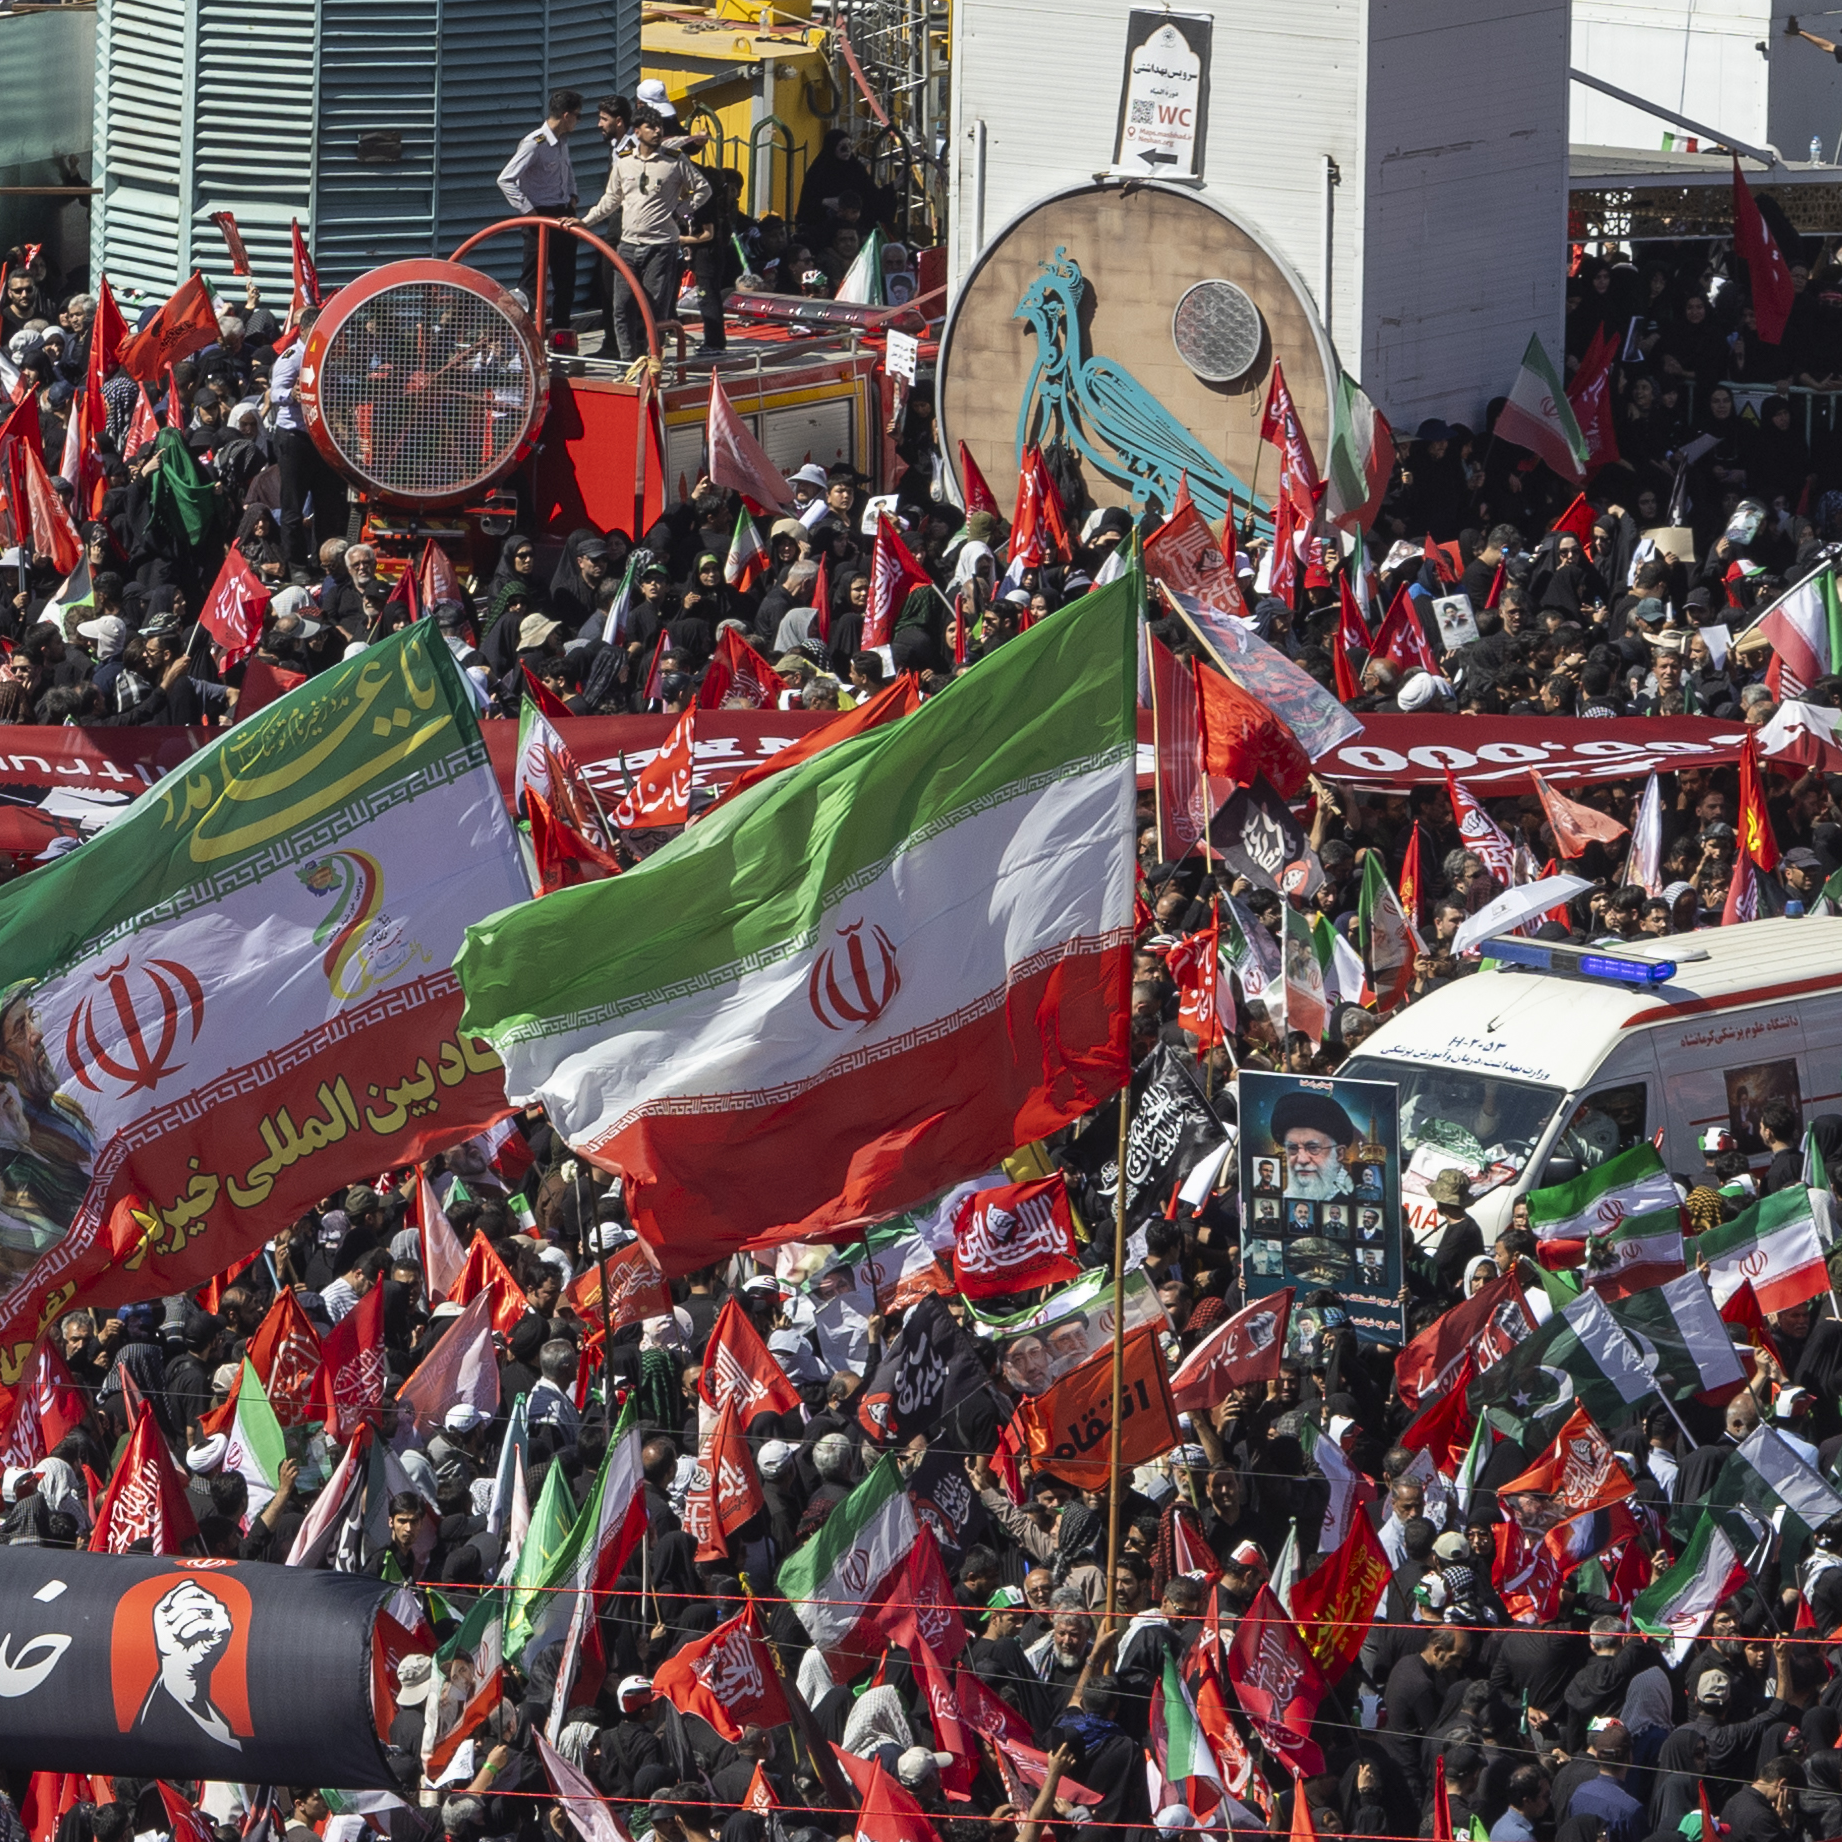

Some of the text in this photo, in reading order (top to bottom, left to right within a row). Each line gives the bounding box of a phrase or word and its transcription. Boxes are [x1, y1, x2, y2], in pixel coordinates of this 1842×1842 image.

[1158, 105, 1192, 127] WC
[1745, 1019, 1765, 1039] علوم
[1767, 1014, 1799, 1032] دانشگاه
[1380, 1044, 1413, 1057] پزشکی
[1522, 1066, 1552, 1081] وزارت
[1043, 1378, 1151, 1462] انتقام
